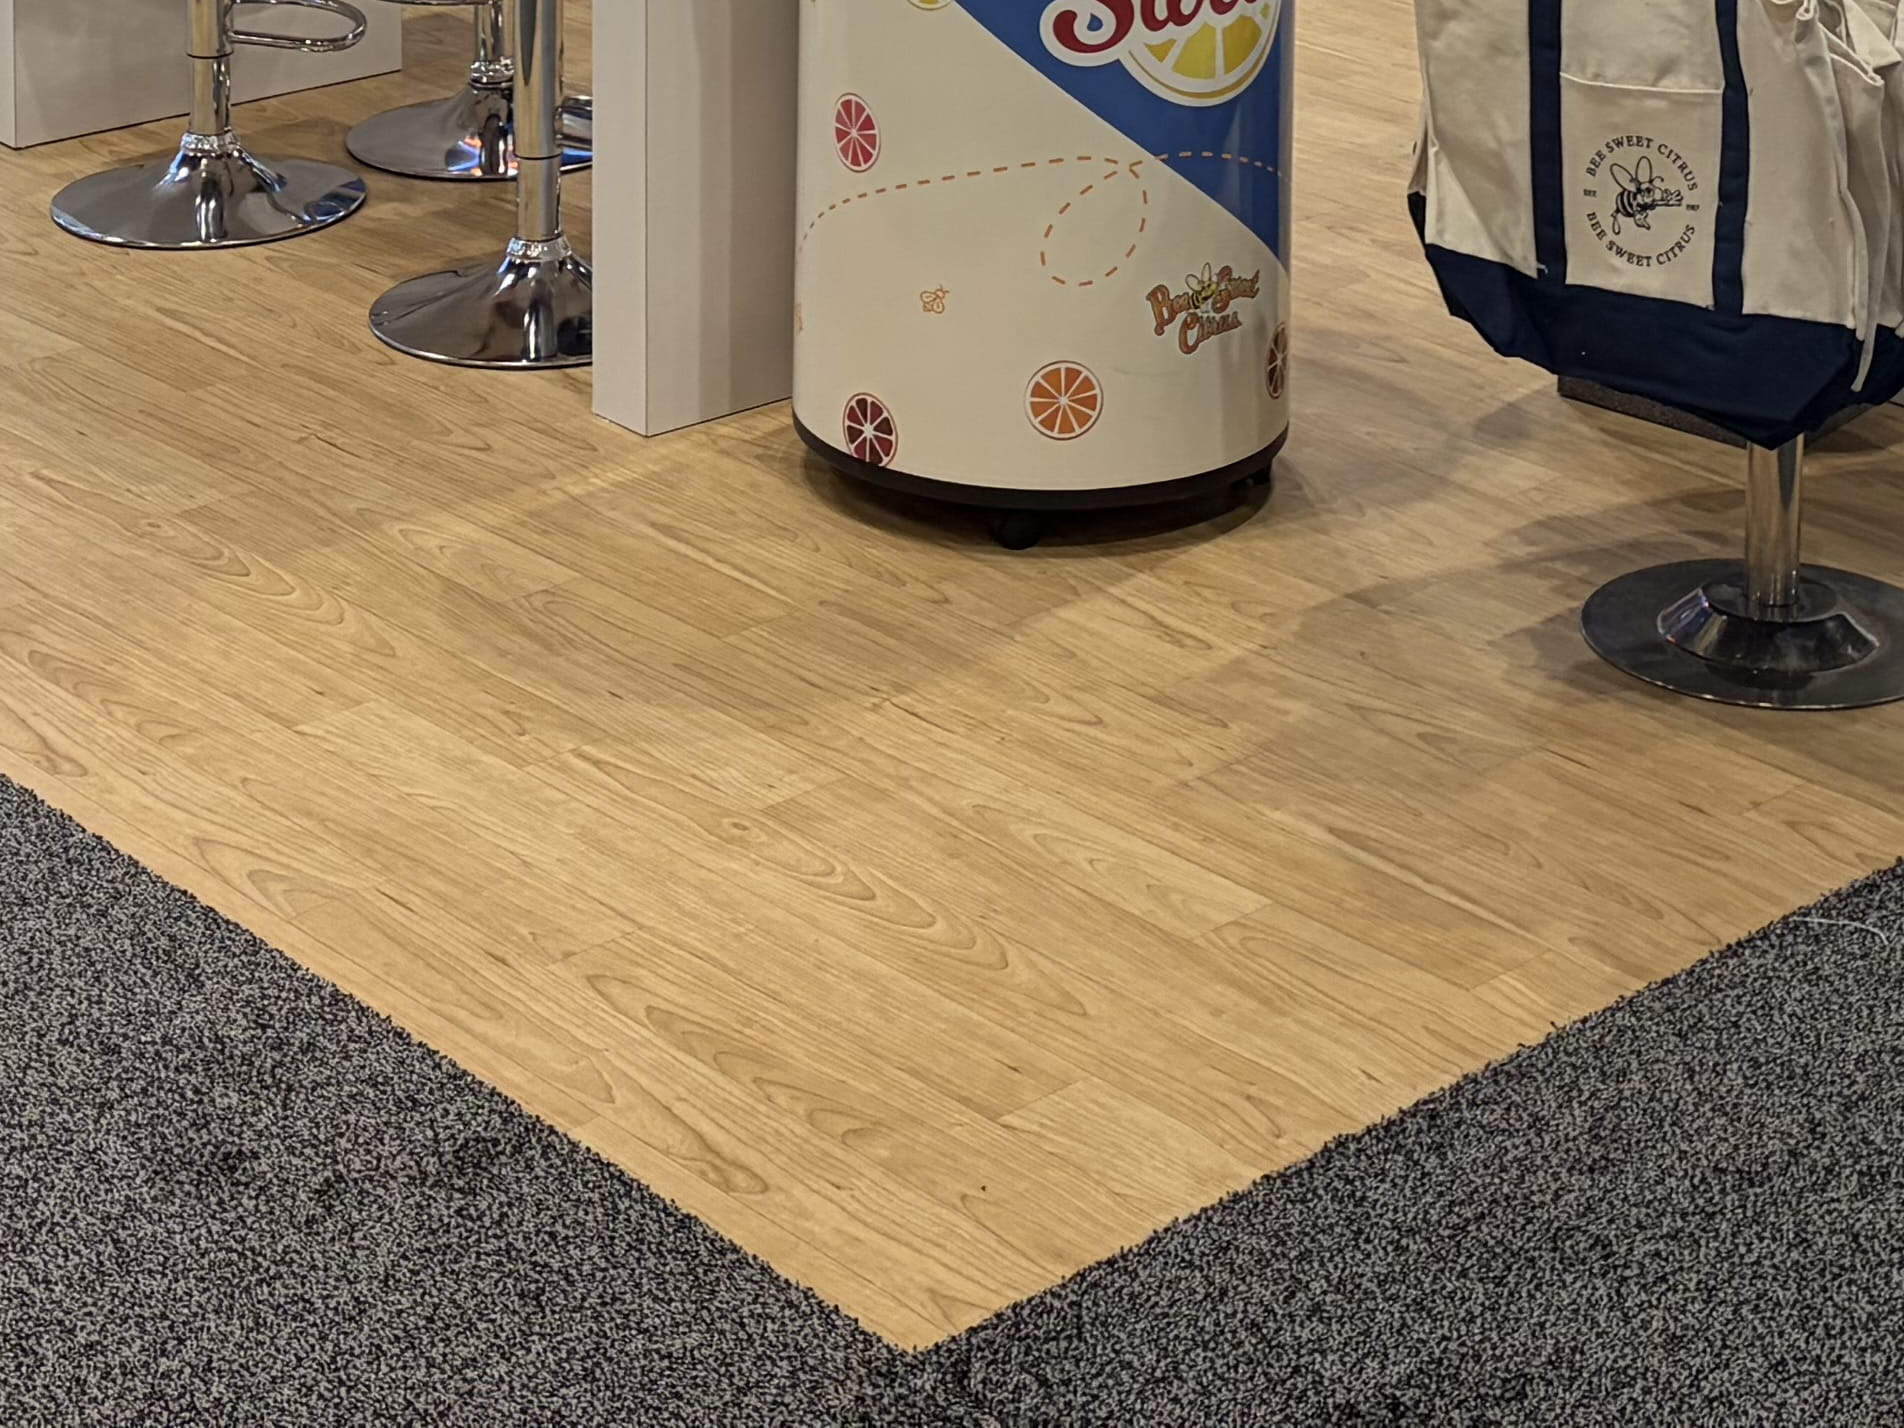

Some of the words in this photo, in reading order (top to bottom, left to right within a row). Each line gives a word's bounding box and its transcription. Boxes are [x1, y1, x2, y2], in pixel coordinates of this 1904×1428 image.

[1585, 149, 1607, 177] BEE
[1605, 135, 1655, 154] SWEET
[1656, 143, 1699, 192] CITRUS
[1586, 211, 1608, 242] BEE
[1606, 239, 1654, 268] SWEET
[1655, 223, 1696, 266] CITRUS
